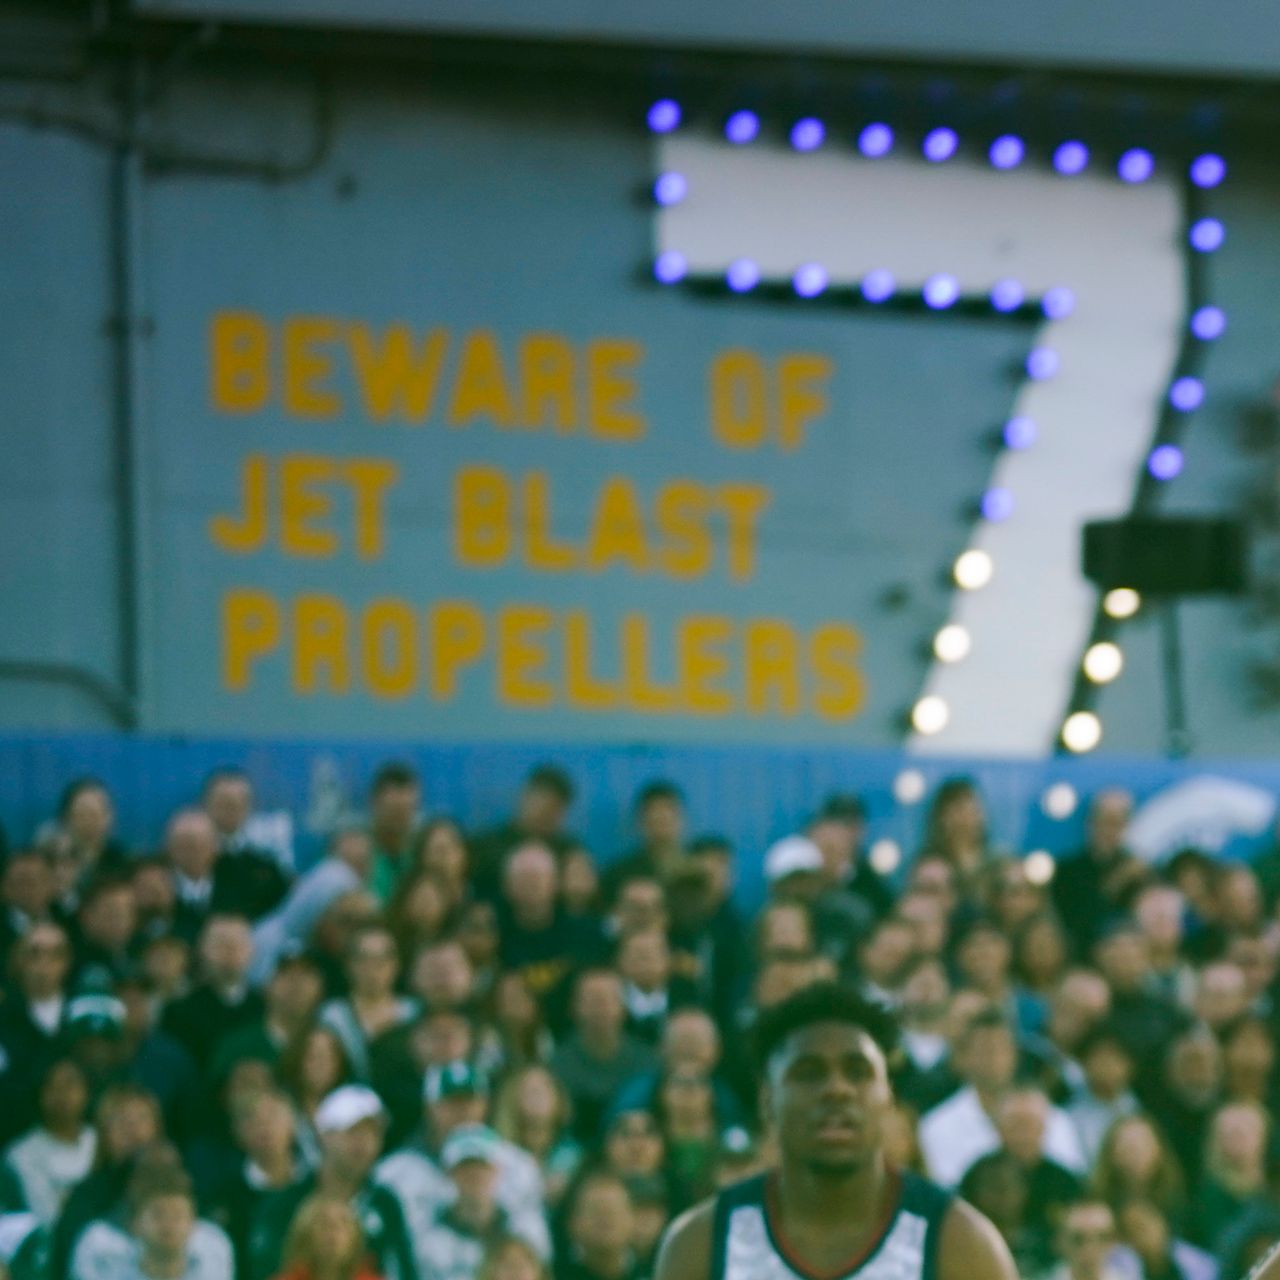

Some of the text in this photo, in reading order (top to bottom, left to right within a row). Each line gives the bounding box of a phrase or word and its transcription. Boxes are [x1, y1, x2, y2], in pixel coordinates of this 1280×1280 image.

[210, 309, 834, 450] BEWARE OF
[210, 453, 771, 584] JET BLAST
[221, 589, 868, 724] PROPELLERS
